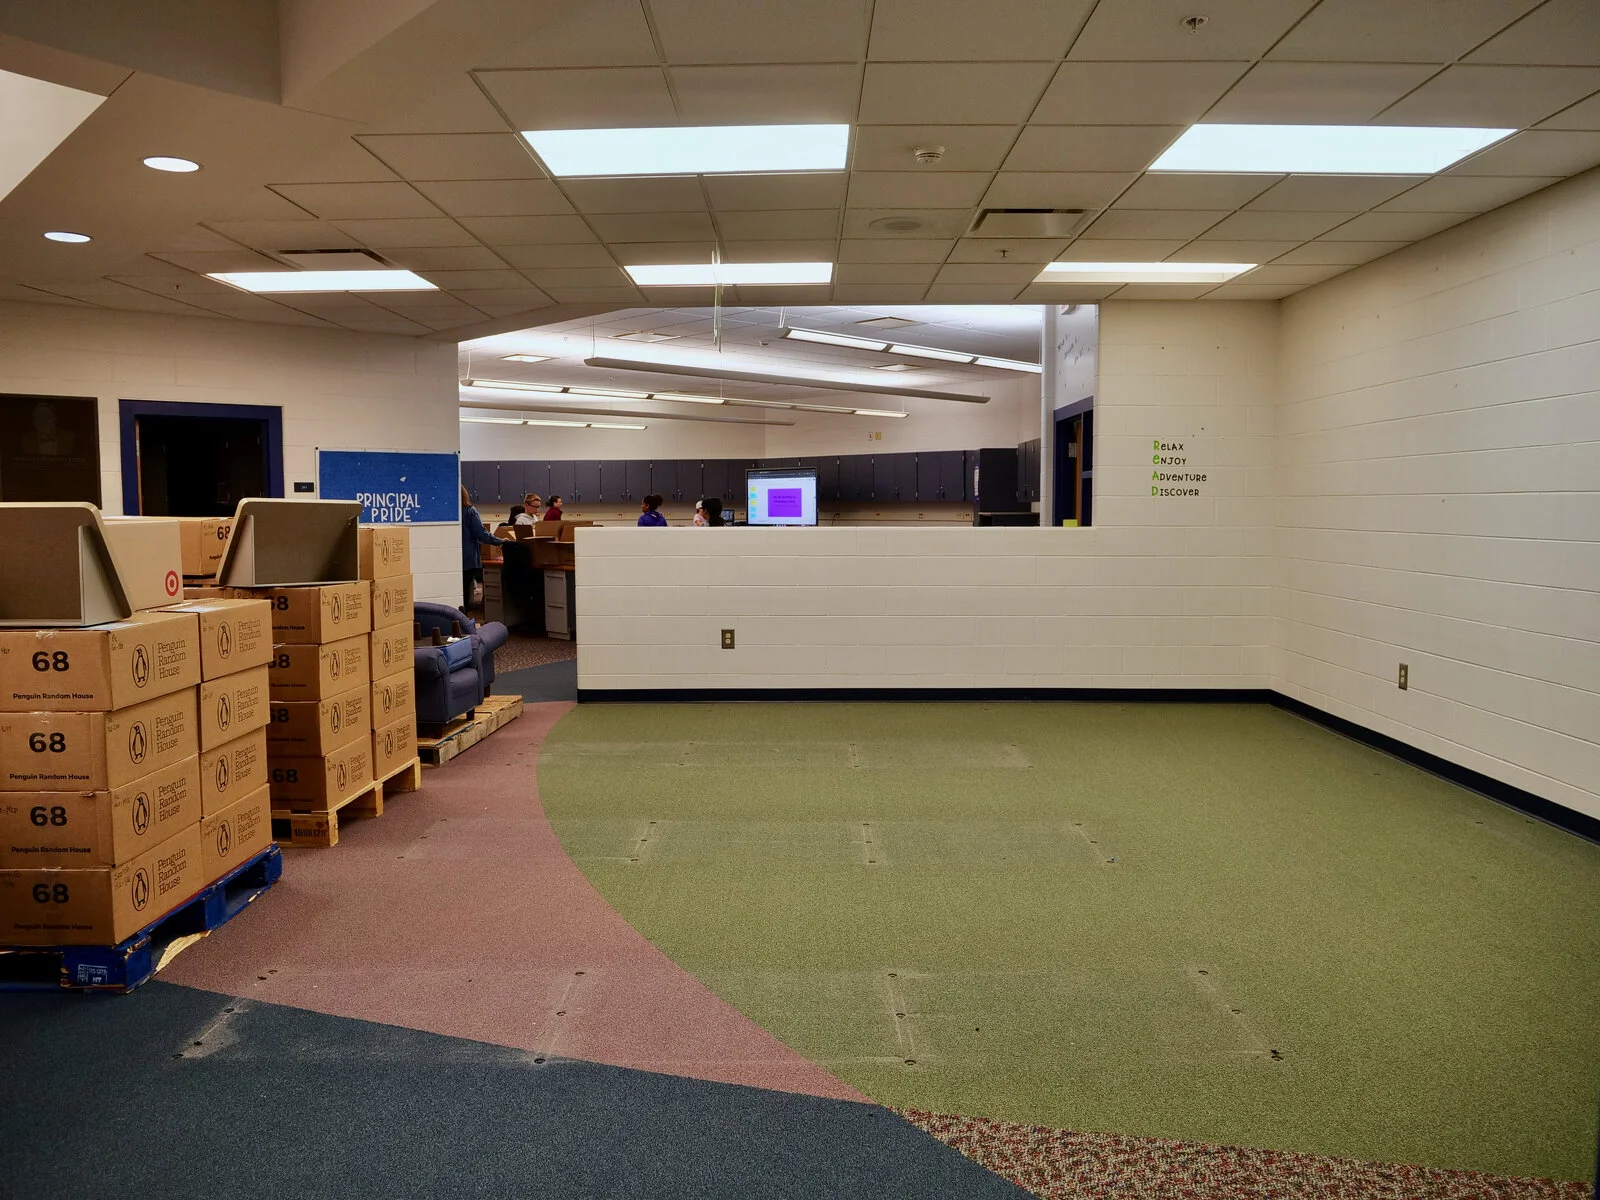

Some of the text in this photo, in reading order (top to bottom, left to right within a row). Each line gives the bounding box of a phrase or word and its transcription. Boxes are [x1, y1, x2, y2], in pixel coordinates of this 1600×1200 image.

[356, 492, 421, 508] PRINCIPAL
[371, 507, 412, 522] PRIDE
[238, 618, 262, 631] Penguin
[238, 629, 262, 642] Random
[157, 638, 186, 654] Penguin
[239, 641, 257, 653] House
[32, 651, 70, 672] 68
[158, 651, 187, 667] Random
[158, 665, 181, 680] House
[155, 710, 184, 729] Penguin
[156, 723, 185, 741] Random
[29, 732, 67, 753] 68
[156, 738, 179, 754] House
[9, 773, 38, 781] Penguin
[273, 768, 298, 783] 68
[157, 777, 187, 798] Penguin
[158, 789, 187, 810] Random
[30, 806, 68, 827] 68
[158, 804, 181, 822] House
[11, 846, 40, 854] Penguin
[157, 848, 187, 872] Penguin
[158, 860, 187, 884] Random
[32, 883, 70, 904] 68
[158, 876, 181, 896] House
